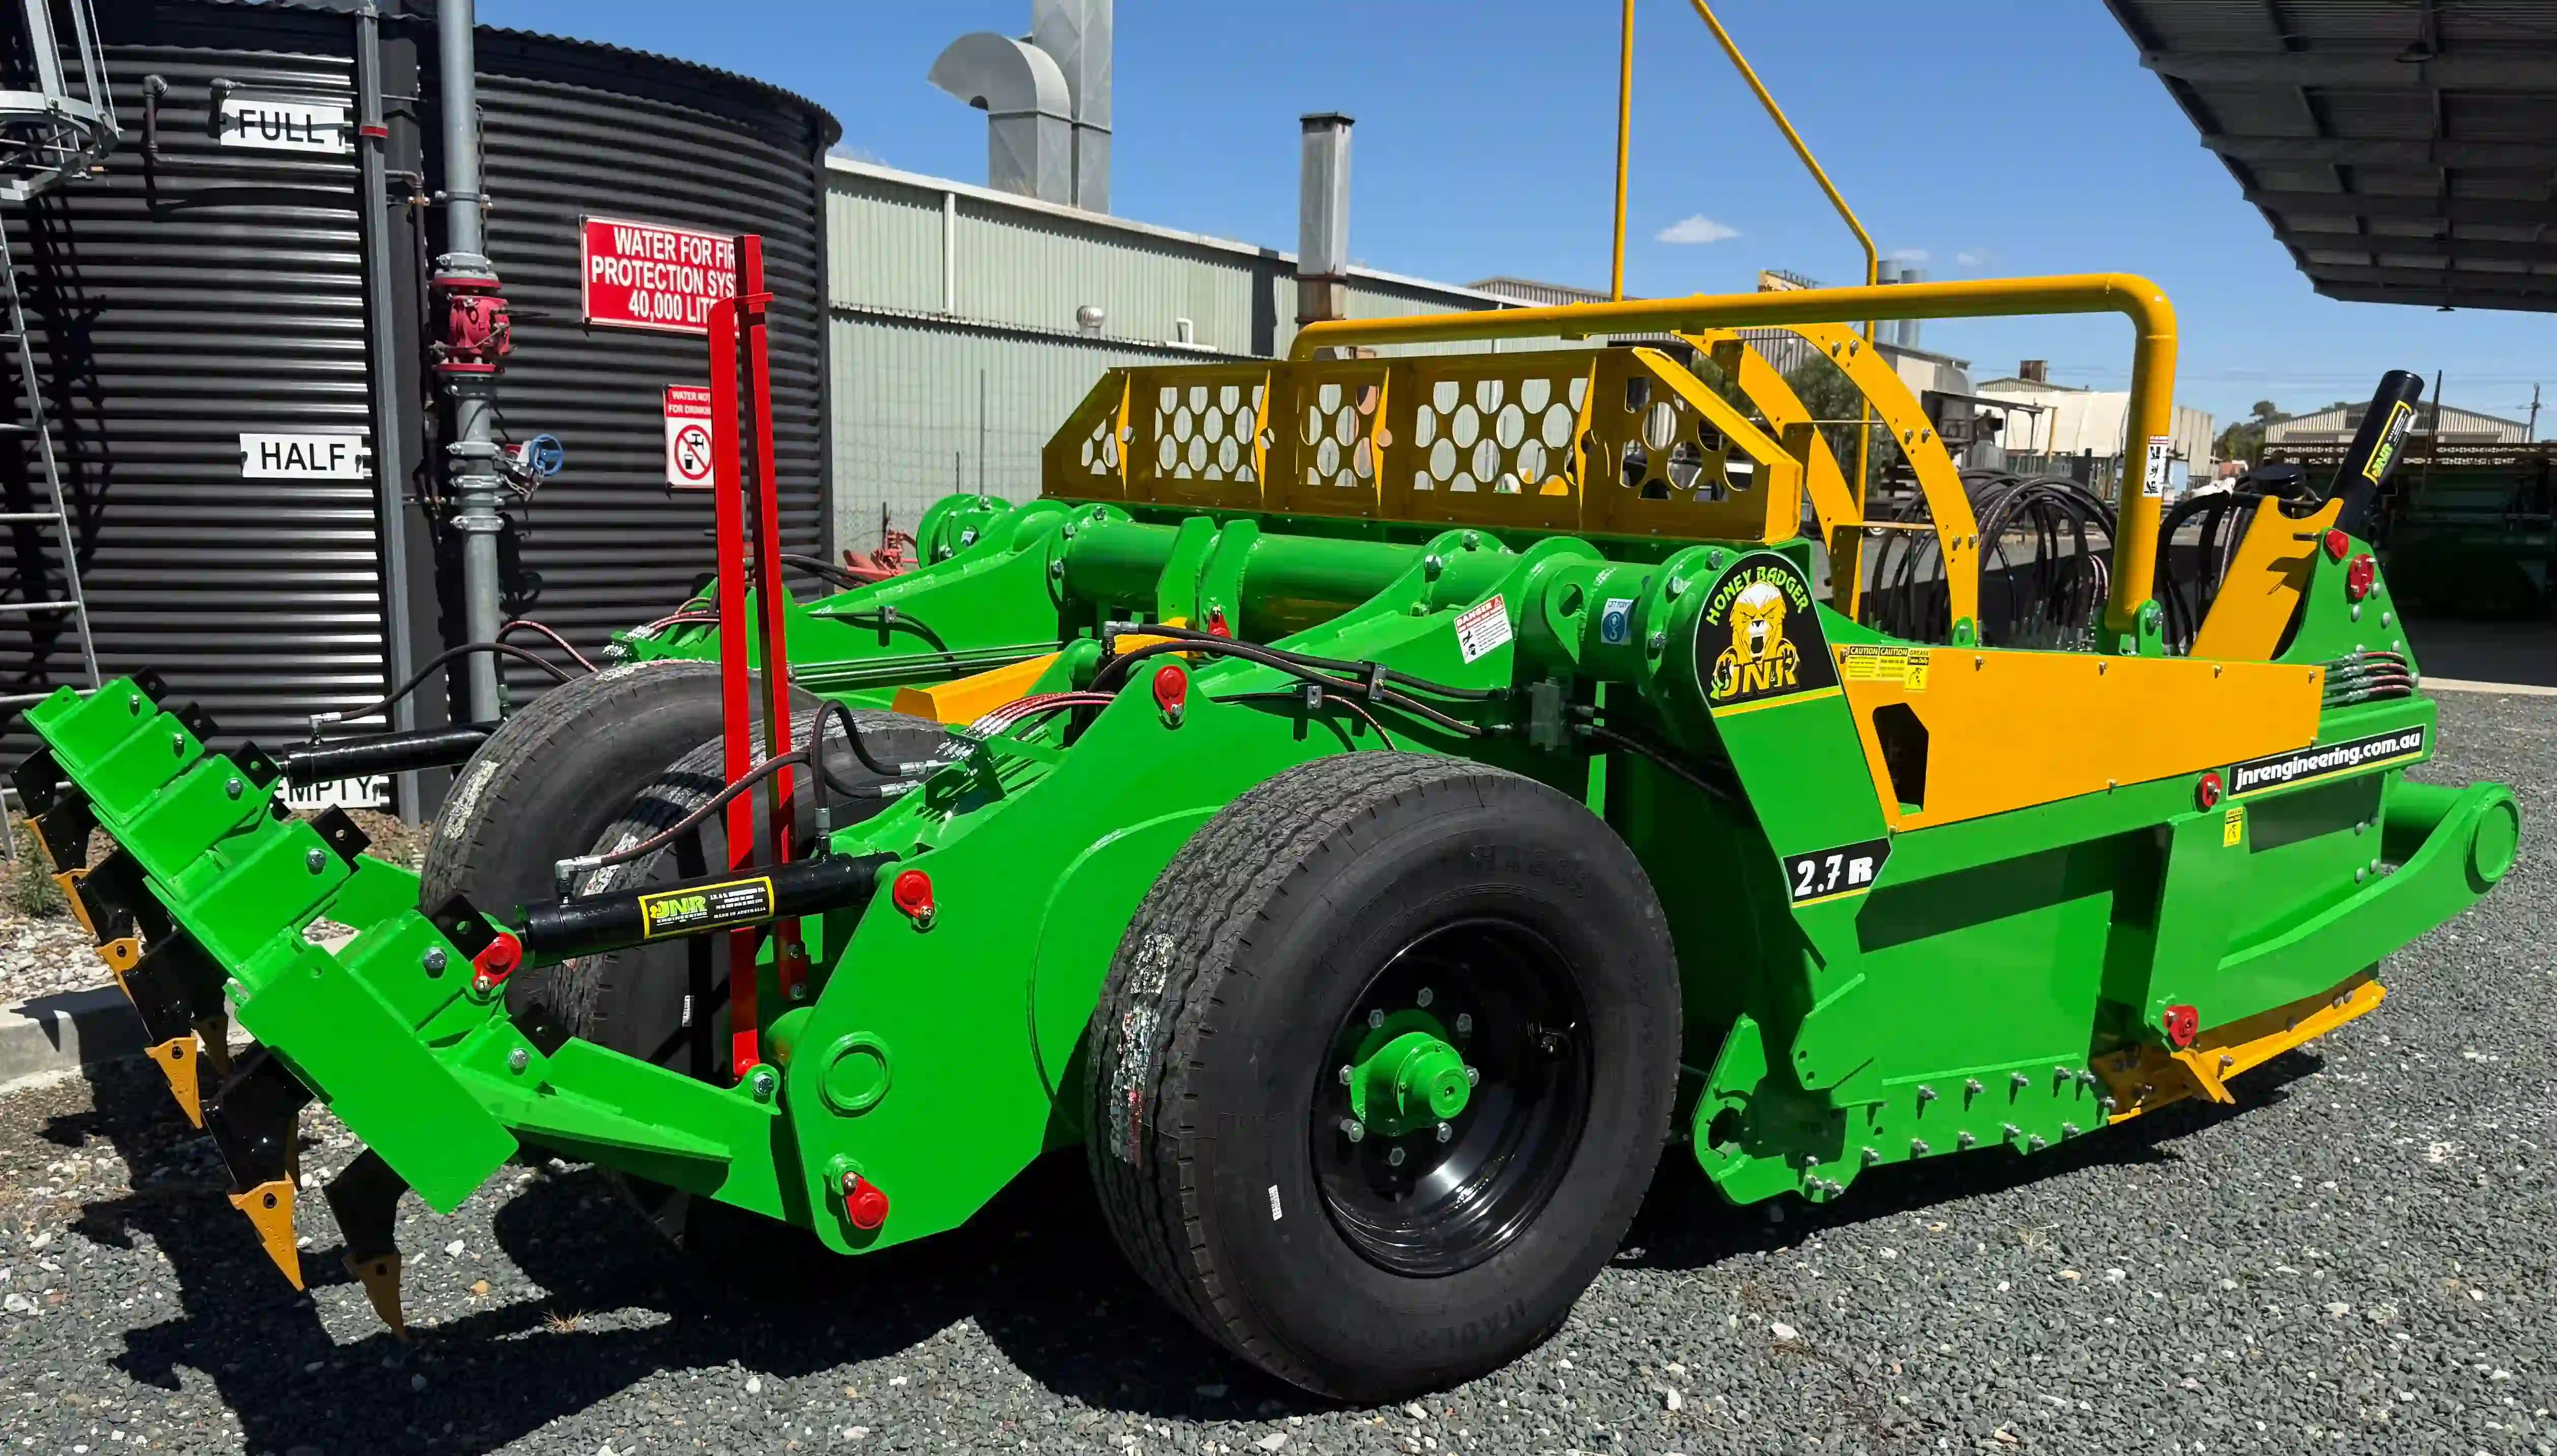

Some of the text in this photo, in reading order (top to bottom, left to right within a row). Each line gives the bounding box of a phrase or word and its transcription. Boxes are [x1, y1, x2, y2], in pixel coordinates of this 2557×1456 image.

[239, 109, 324, 143] FULL
[614, 227, 736, 271] WATER FOR FIR
[592, 255, 736, 300] PROTECTION SYS
[628, 290, 719, 324] 40,000 LIT
[261, 442, 345, 471] HALF
[1706, 566, 1809, 626] HONEY BADGER
[1850, 647, 1878, 656] CAUTION
[1880, 648, 1908, 656] CAUTION
[2235, 733, 2420, 791] jnrengineering.com.au
